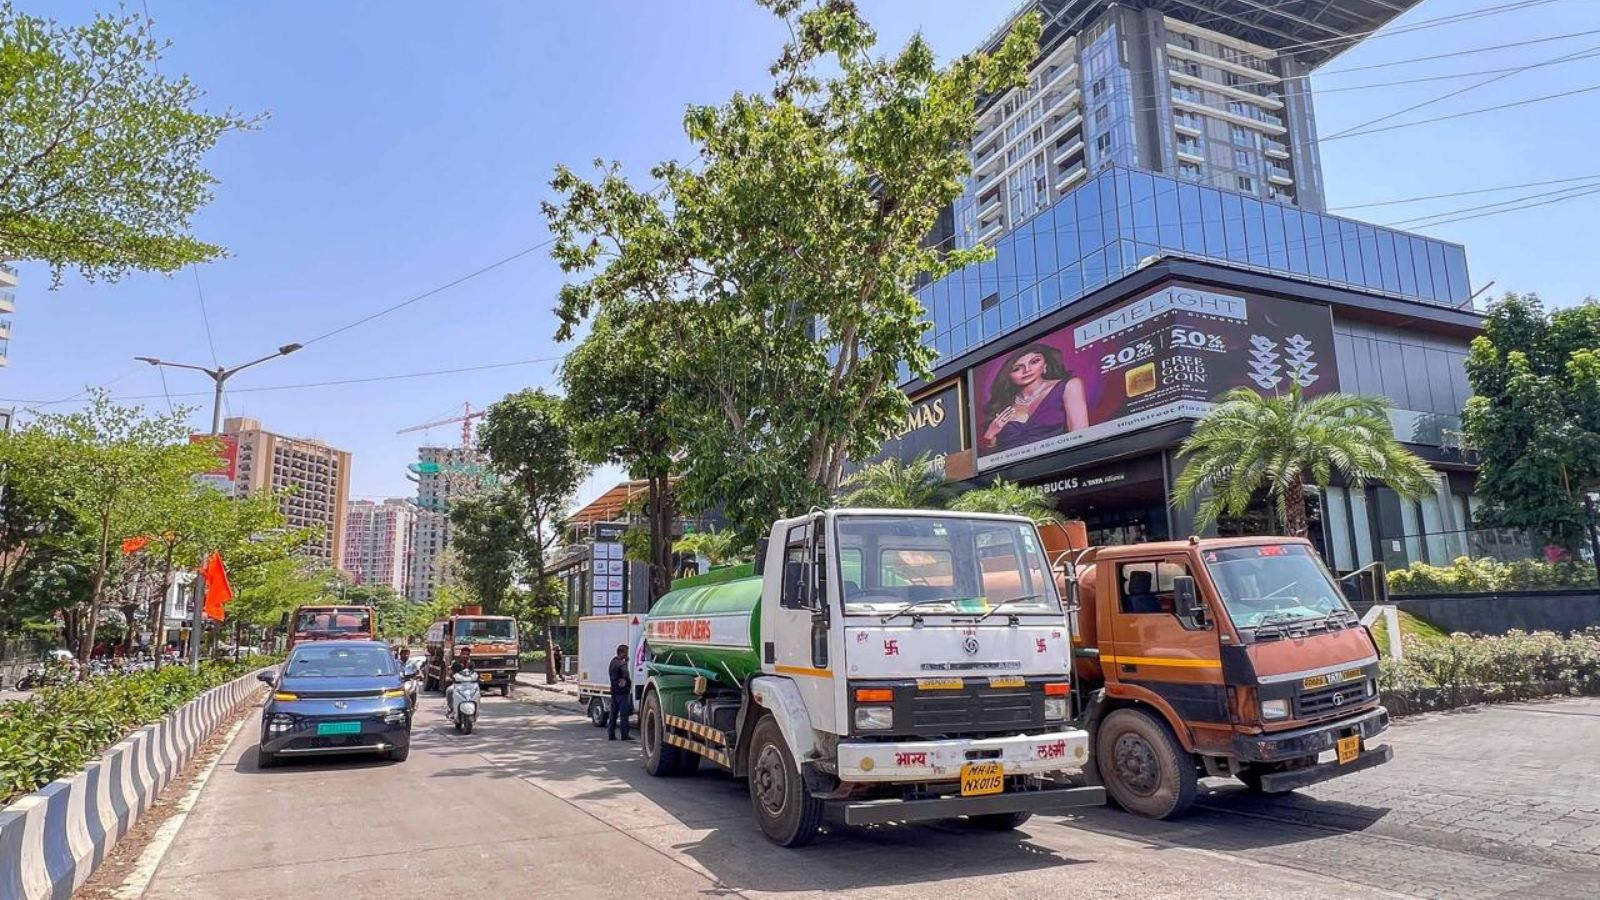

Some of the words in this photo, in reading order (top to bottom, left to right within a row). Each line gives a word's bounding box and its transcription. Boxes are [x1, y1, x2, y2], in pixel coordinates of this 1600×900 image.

[1083, 291, 1238, 341] LIMELIGHT
[1187, 311, 1249, 326] DIAMONDS
[1170, 328, 1223, 347] 50%
[1100, 340, 1153, 370] 30%
[1161, 355, 1204, 369] FREE
[1161, 364, 1205, 377] GOLD
[1020, 477, 1078, 496] ARBUCKS
[963, 776, 1001, 792] NX0115
